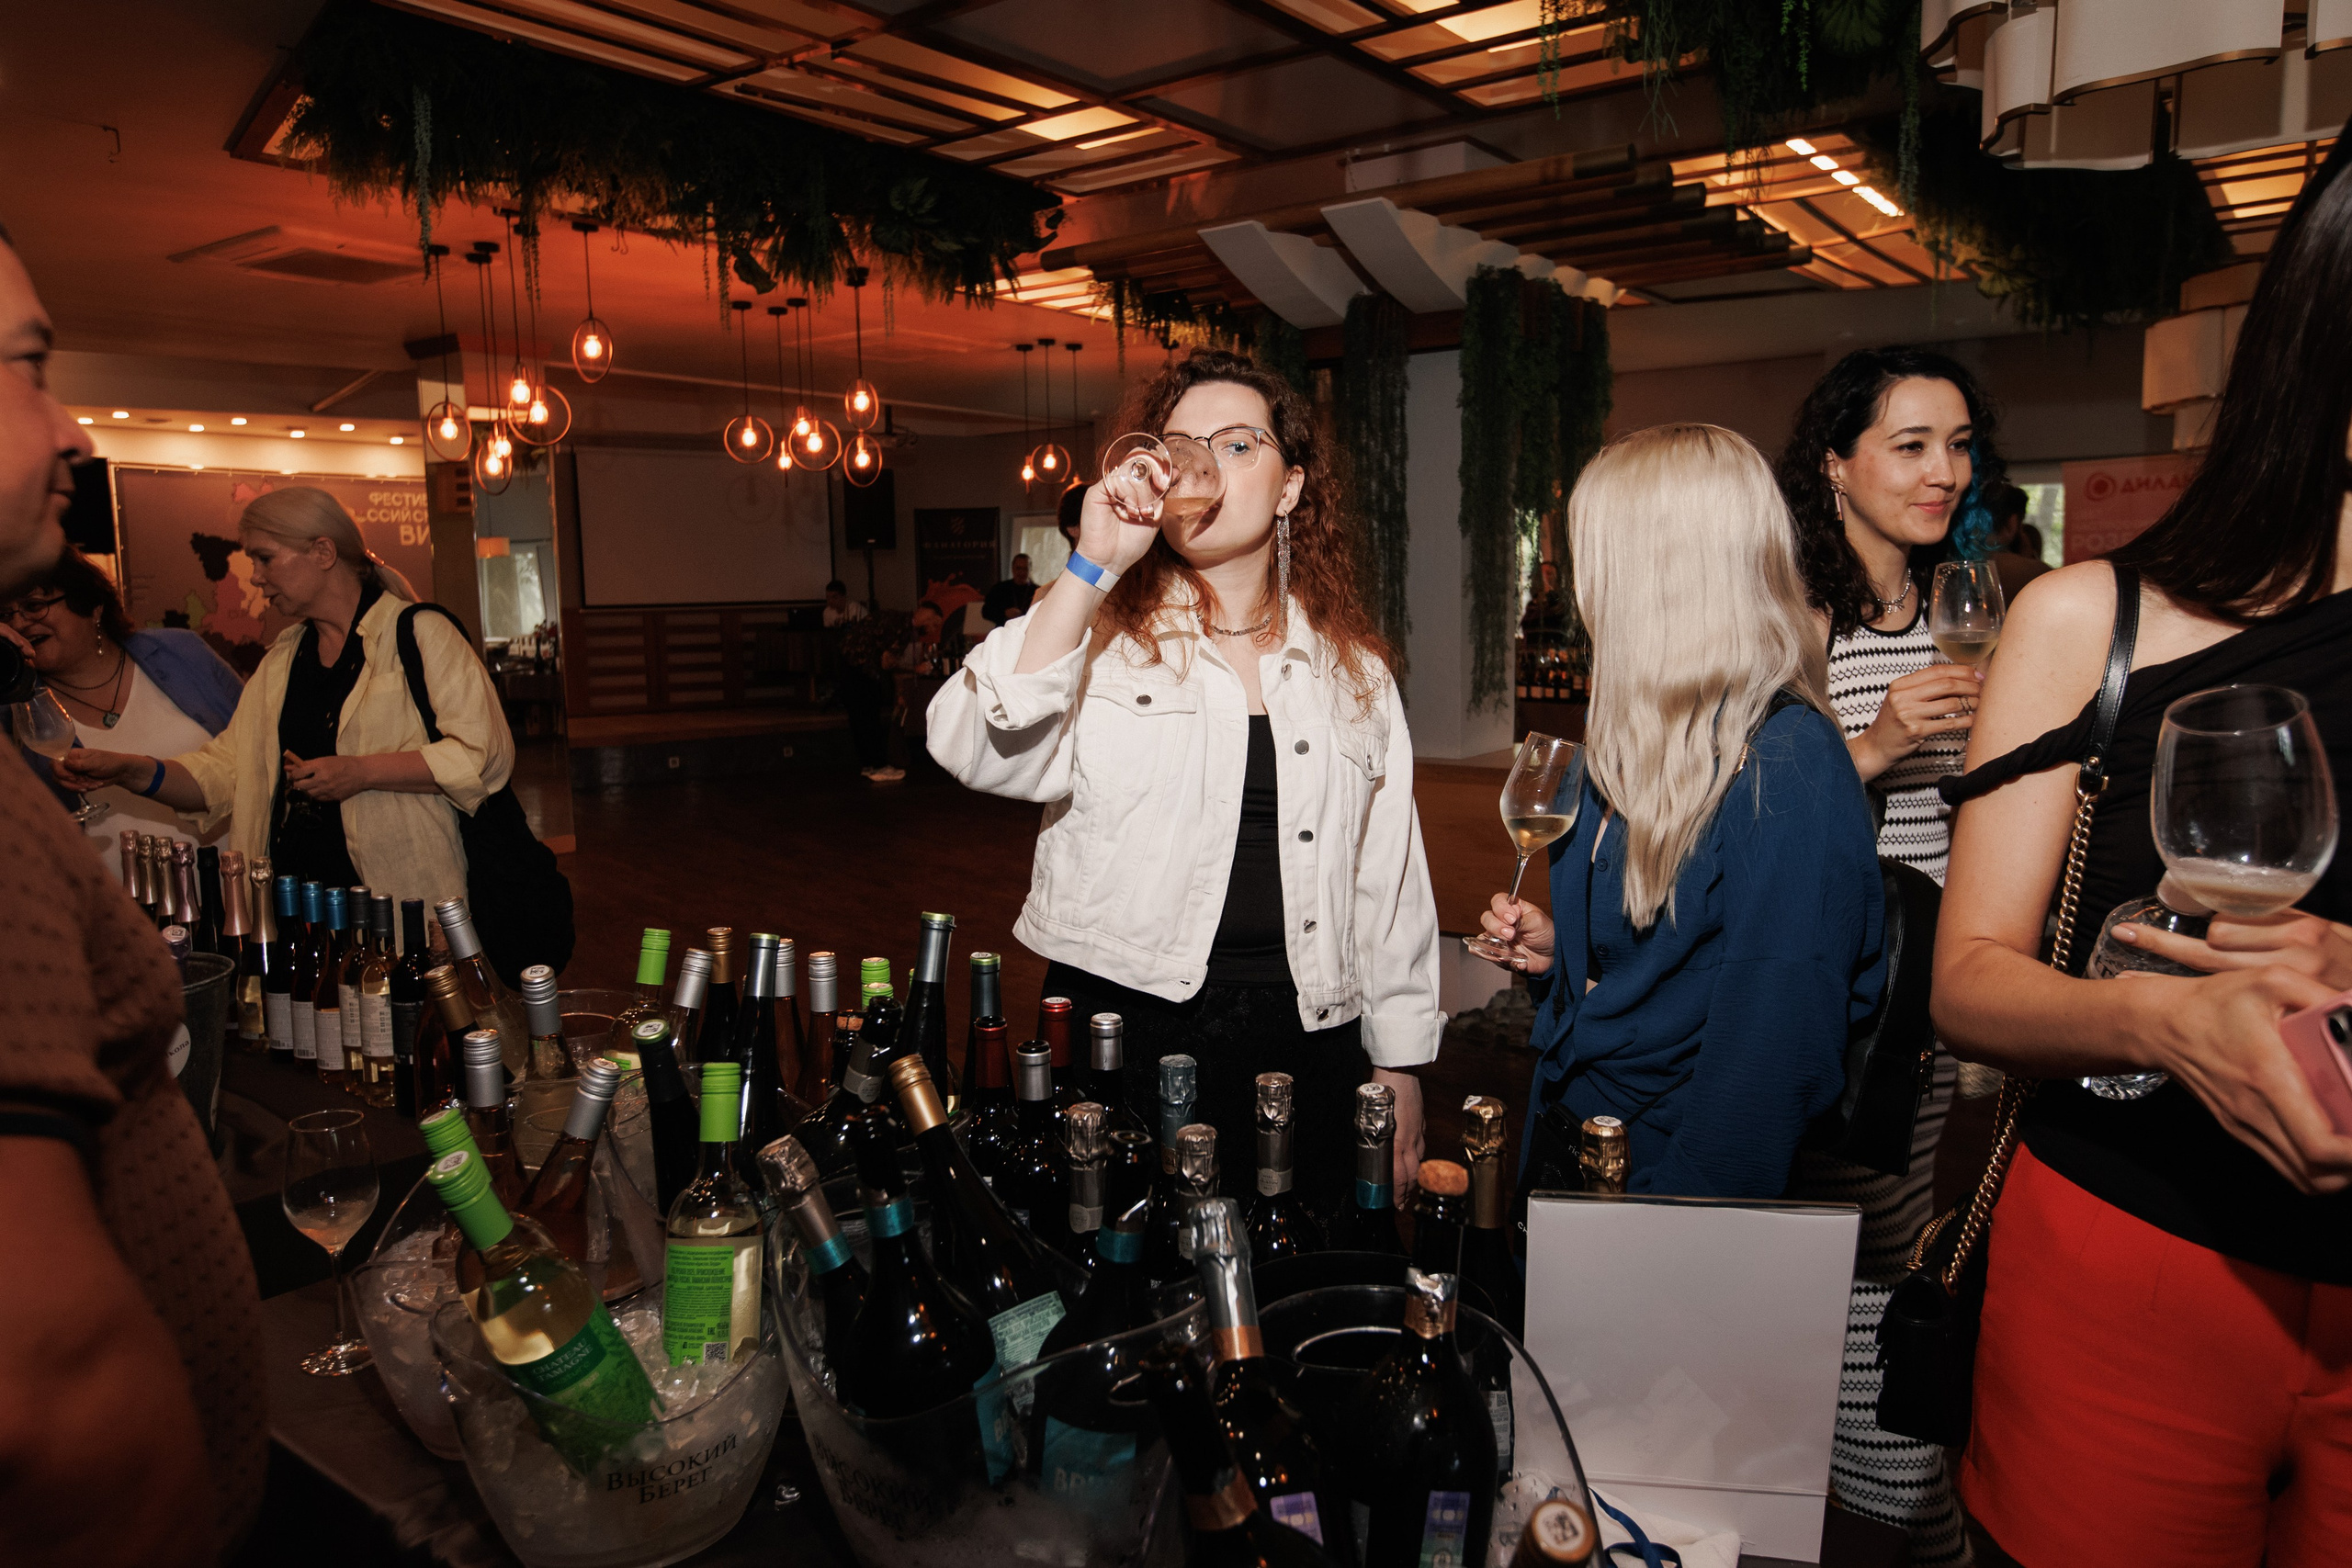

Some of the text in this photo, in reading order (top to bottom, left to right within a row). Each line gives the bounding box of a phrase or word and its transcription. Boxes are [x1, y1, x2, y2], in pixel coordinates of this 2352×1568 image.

[348, 505, 429, 524] ССИЙС
[166, 1040, 190, 1056] кола
[533, 1337, 587, 1375] CHATEAU
[537, 1343, 594, 1382] TAMAGNE
[606, 1433, 738, 1492] ВЫСОКИЙ
[639, 1466, 713, 1505] БЕРЕГ
